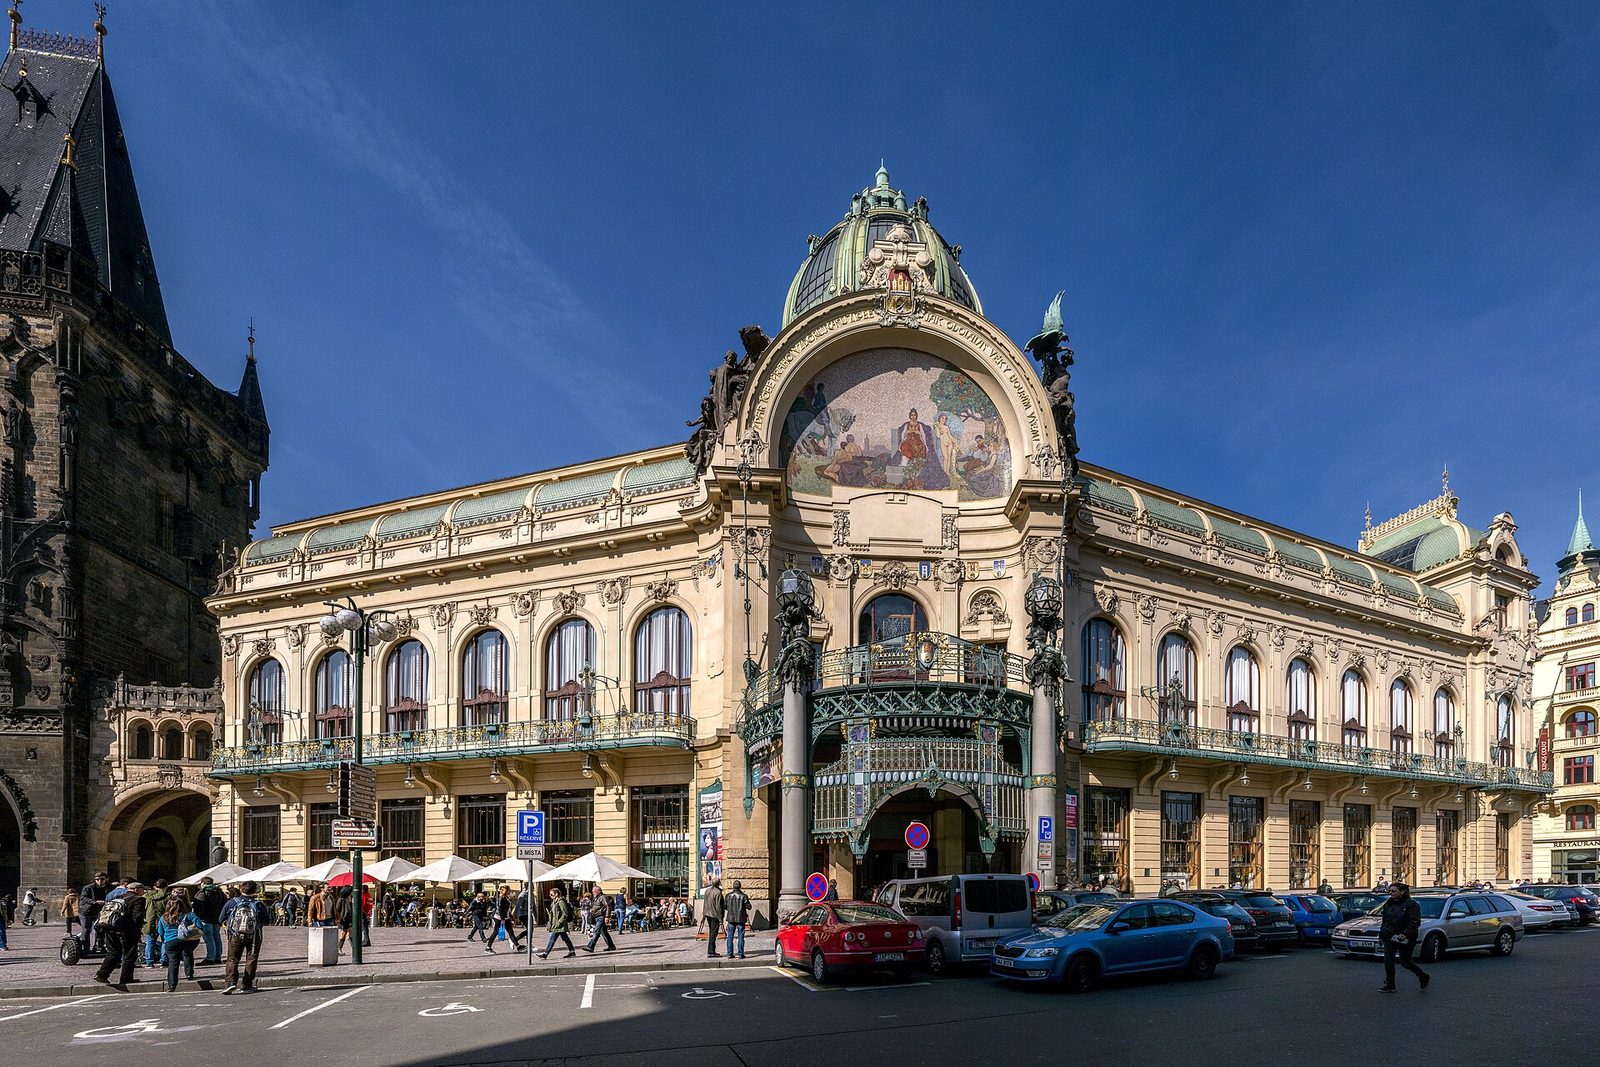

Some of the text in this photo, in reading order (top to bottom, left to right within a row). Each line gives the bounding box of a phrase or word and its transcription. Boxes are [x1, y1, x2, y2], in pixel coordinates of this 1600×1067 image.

[523, 815, 539, 834] P
[1041, 819, 1050, 834] P
[524, 848, 541, 856] MÍSTA
